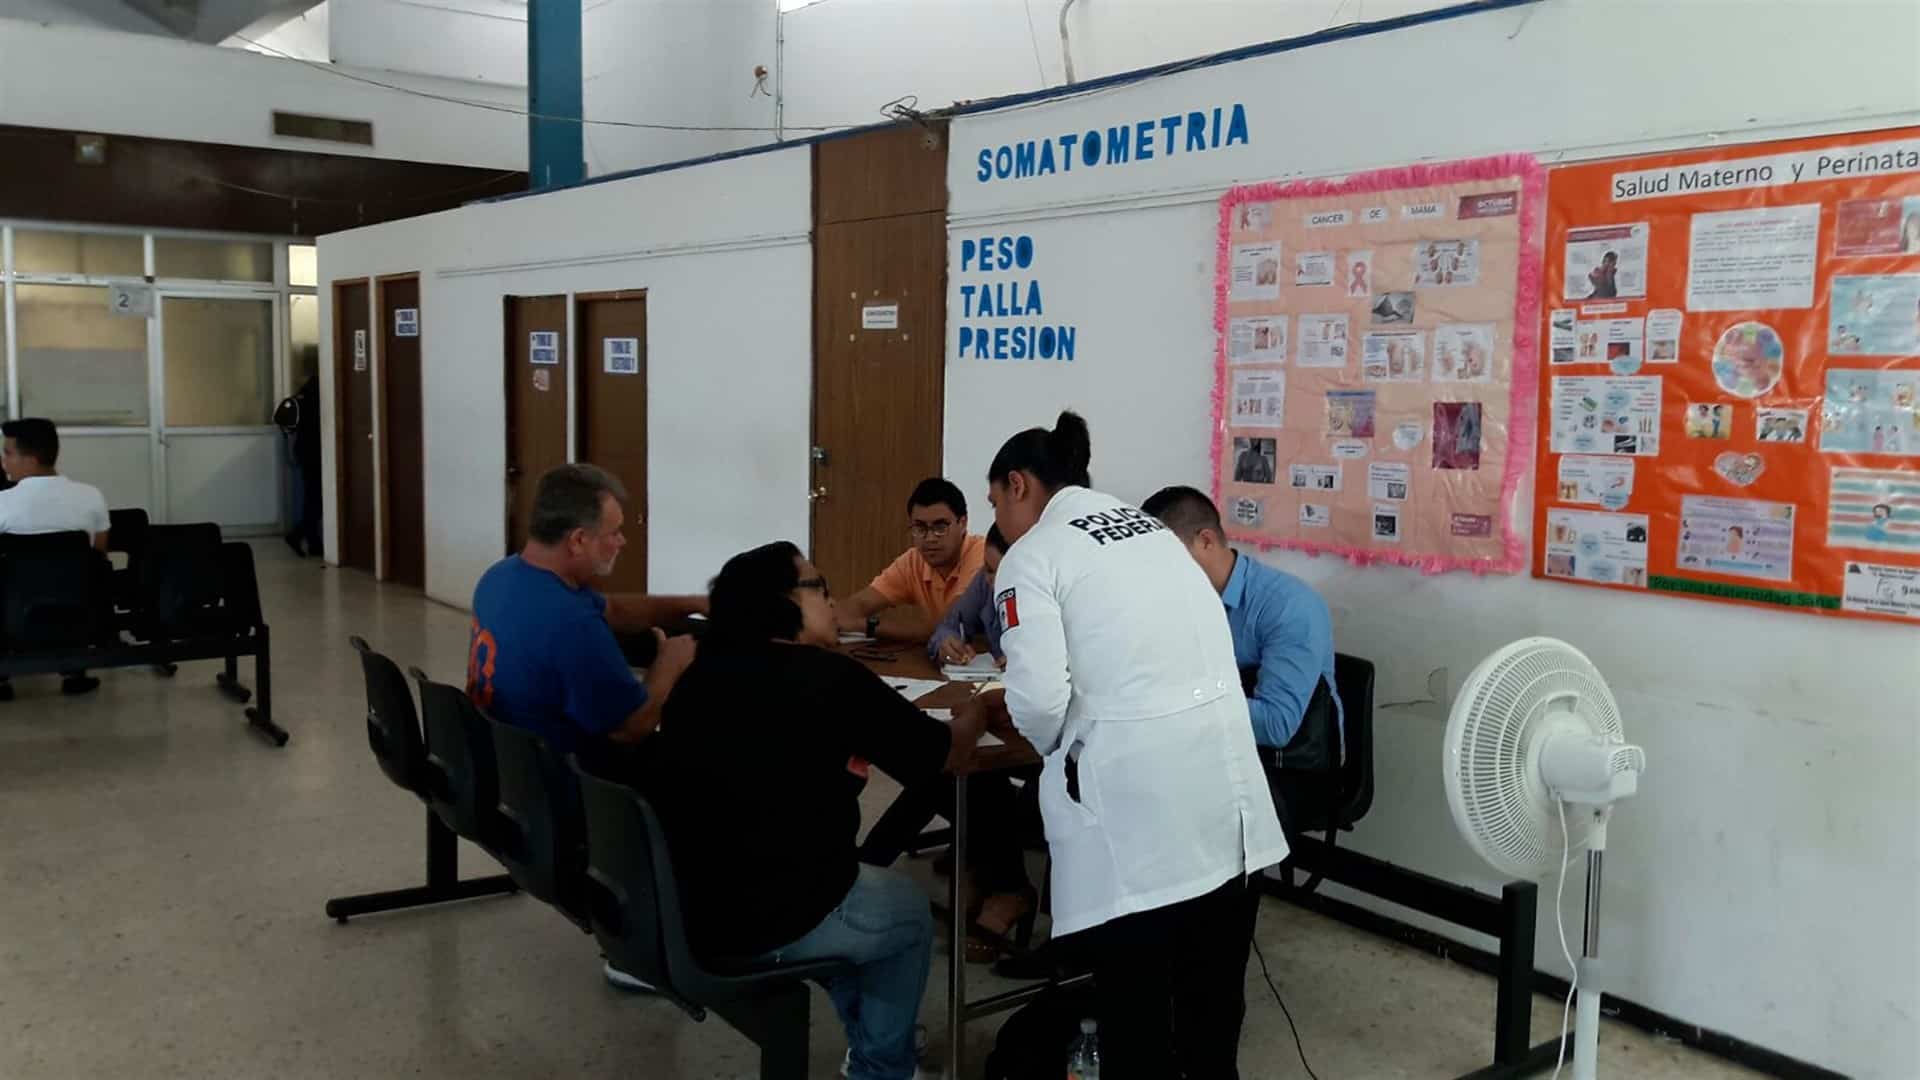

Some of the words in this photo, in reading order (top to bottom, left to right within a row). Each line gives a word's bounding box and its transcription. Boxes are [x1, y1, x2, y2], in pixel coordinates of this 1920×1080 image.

[977, 104, 1249, 182] SOMATOMETRIA
[1614, 174, 1670, 198] Salud
[1679, 164, 1773, 190] Materno
[1791, 162, 1805, 183] y
[1817, 149, 1920, 176] Perinata
[1311, 213, 1345, 225] CANCER
[961, 236, 1034, 272] PESO
[119, 294, 129, 308] 2
[960, 280, 1042, 318] TALLA
[958, 326, 1076, 361] PRESION
[1068, 508, 1149, 531] POLIC
